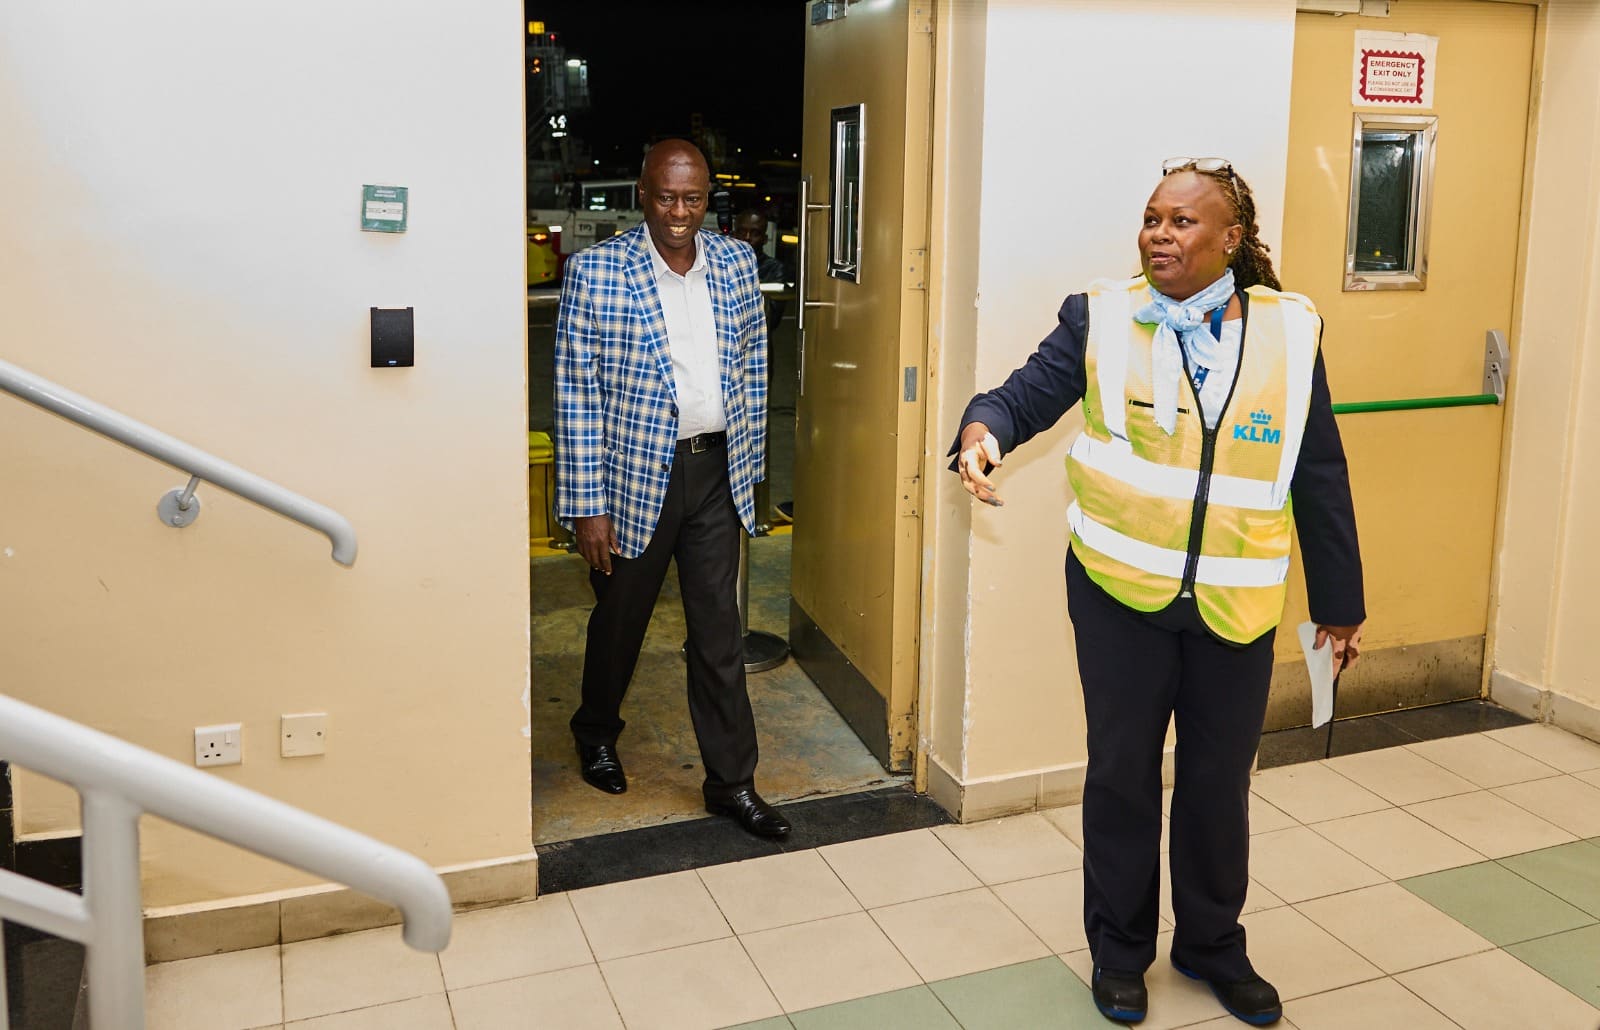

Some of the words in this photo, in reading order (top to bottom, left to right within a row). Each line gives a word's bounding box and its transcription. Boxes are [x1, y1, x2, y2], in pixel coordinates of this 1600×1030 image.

[1370, 60, 1416, 69] EMERGENCY
[1373, 69, 1391, 77] EXIT
[1392, 70, 1412, 78] ONLY
[1233, 424, 1280, 444] KLM
